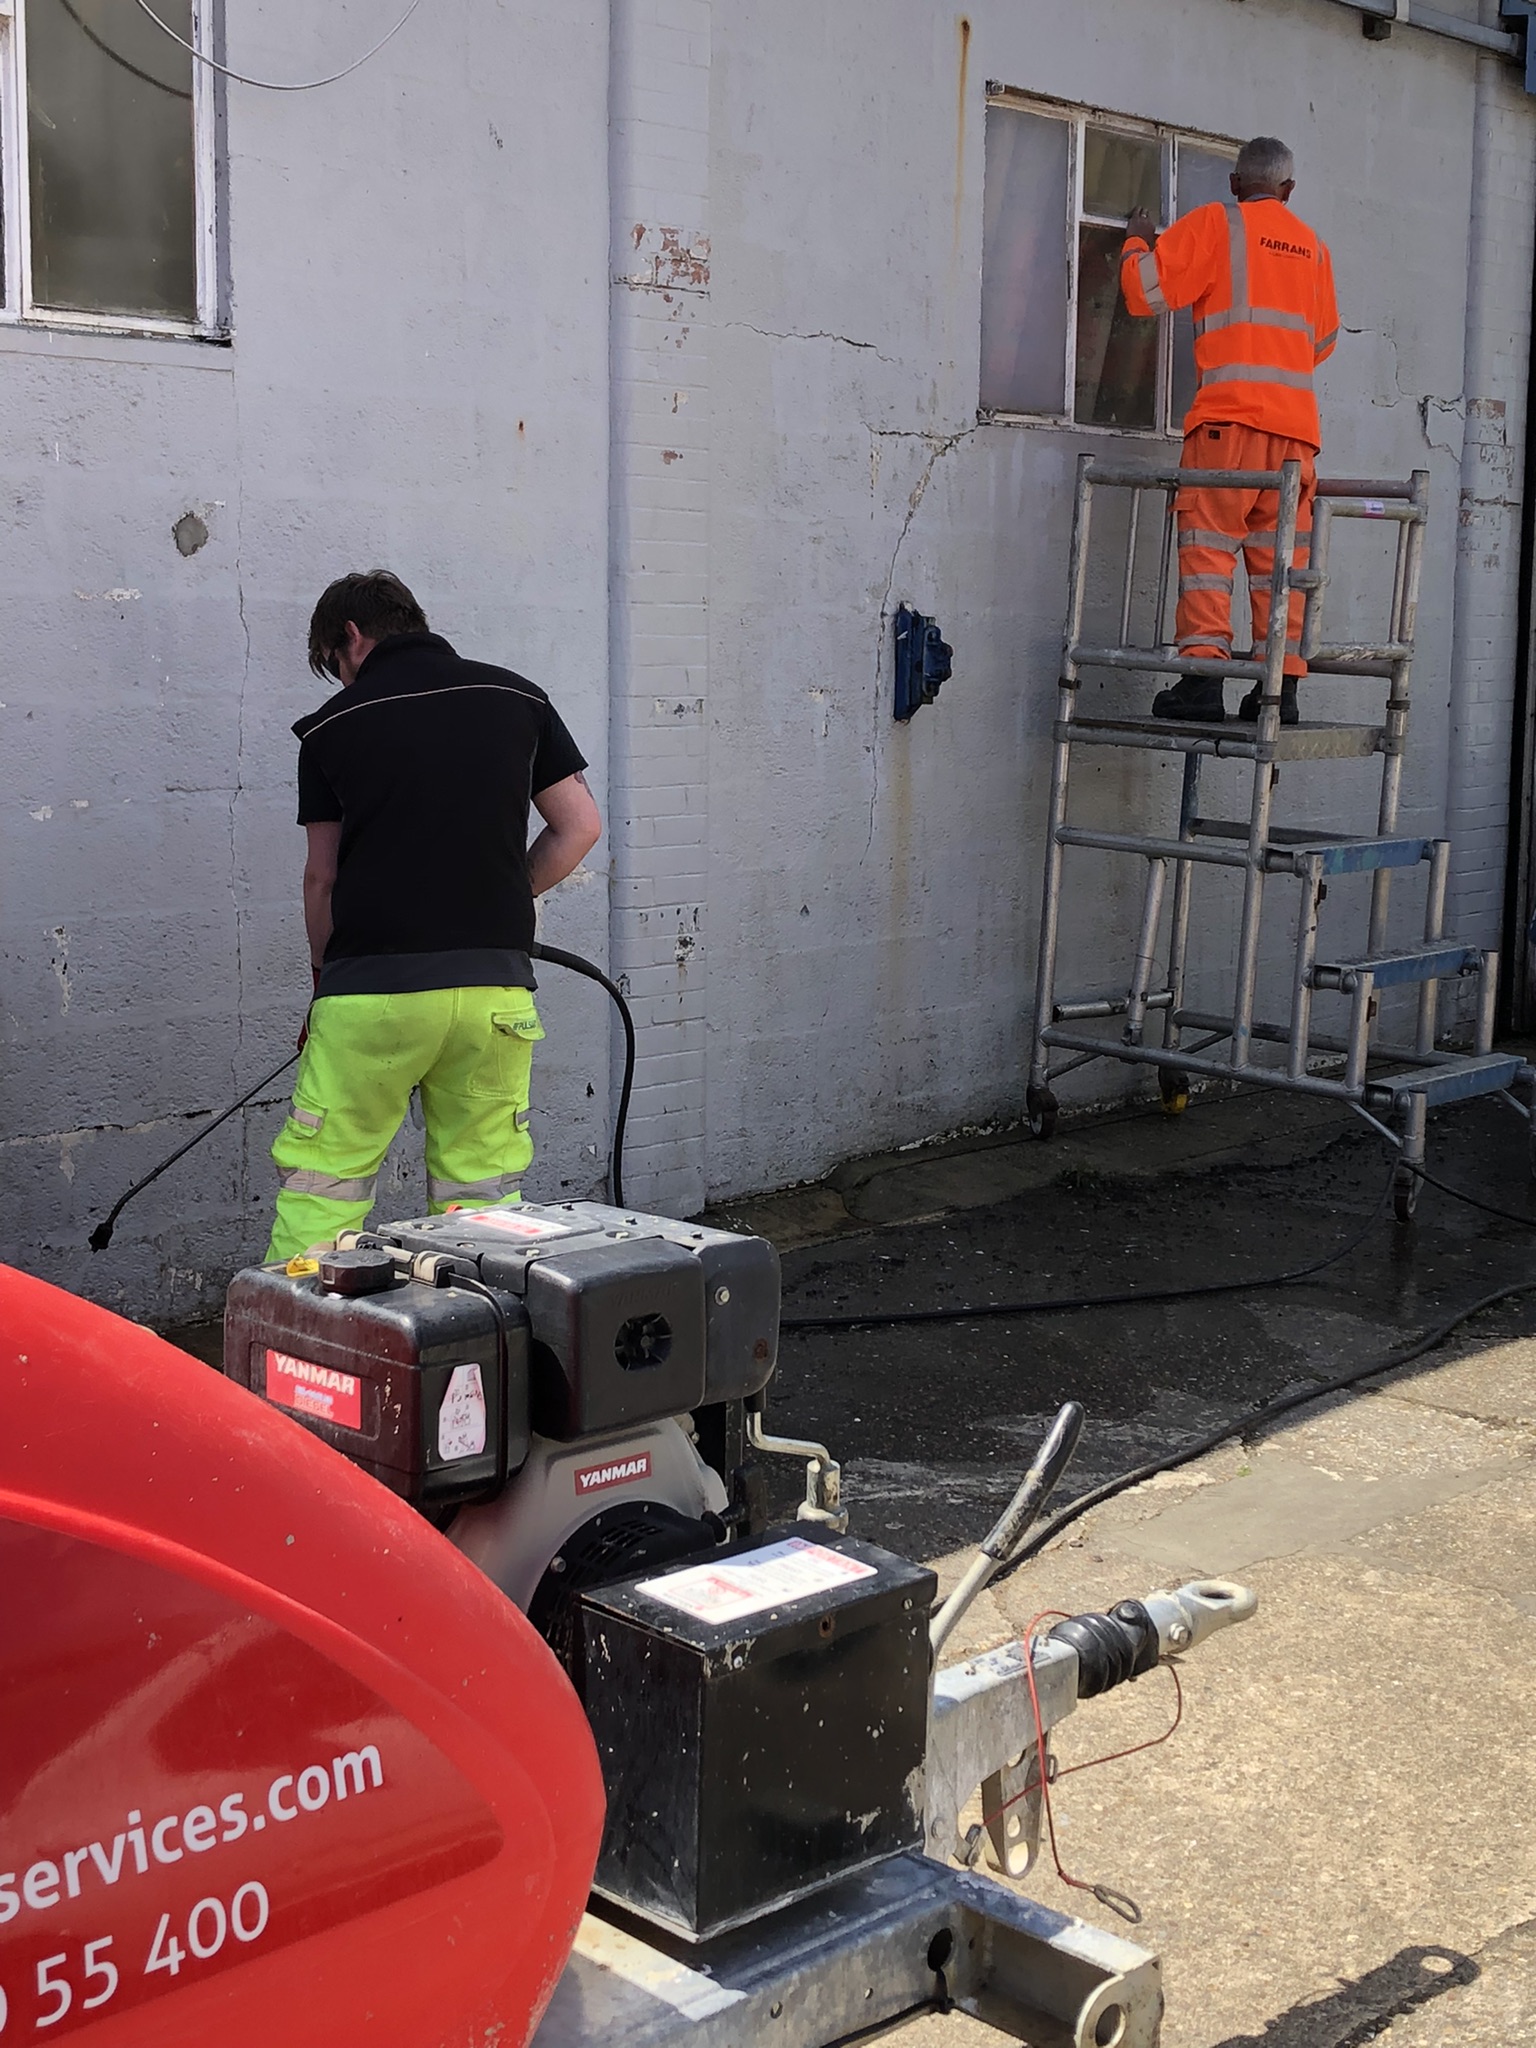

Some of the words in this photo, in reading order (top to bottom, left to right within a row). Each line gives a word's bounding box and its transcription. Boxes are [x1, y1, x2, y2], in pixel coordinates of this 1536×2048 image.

[1260, 237, 1311, 259] FARRANS
[274, 1352, 355, 1396] YANMAR
[580, 1458, 647, 1488] YANMAR
[36, 1935, 118, 2027] 55
[144, 1881, 269, 1975] 400
